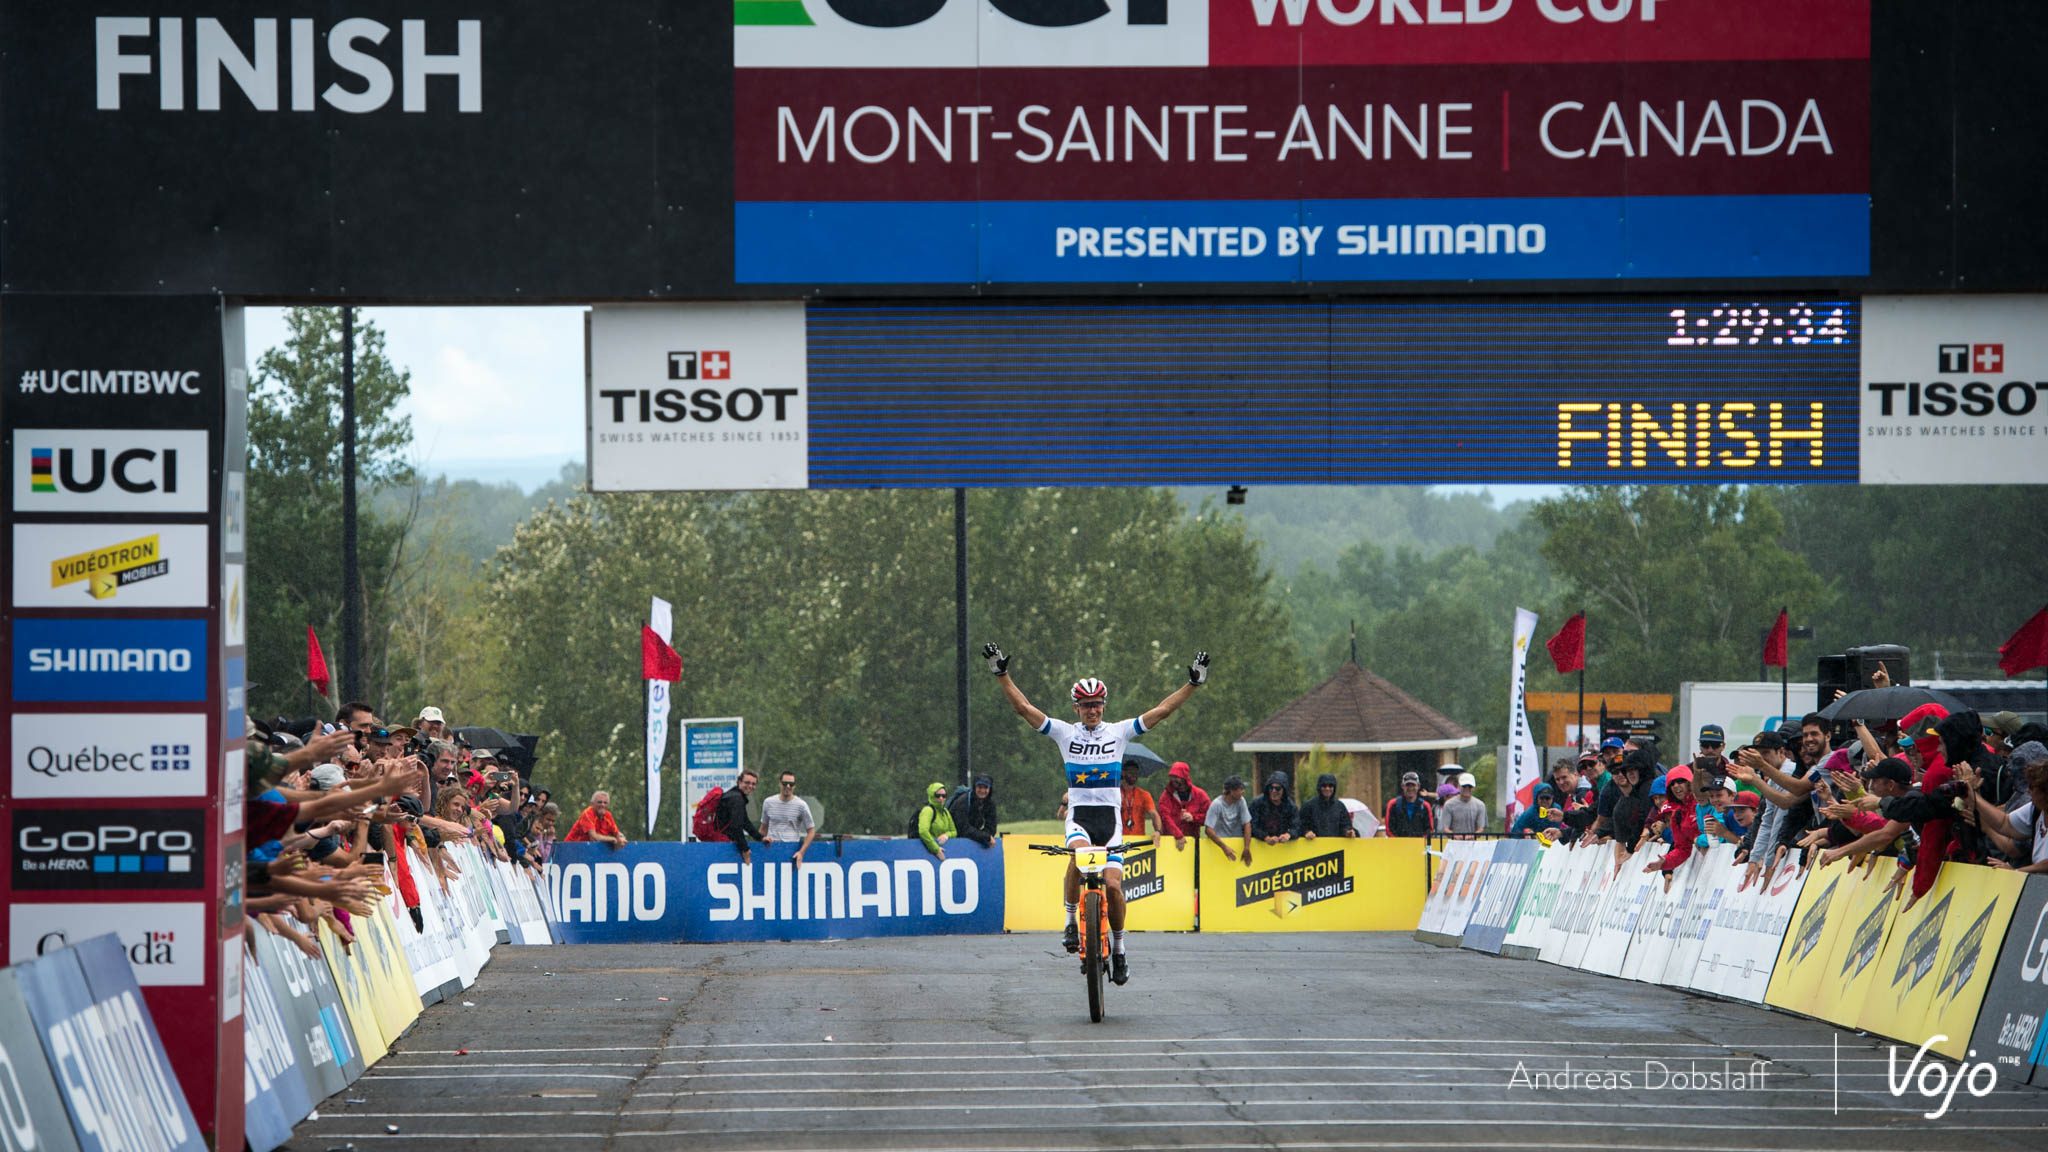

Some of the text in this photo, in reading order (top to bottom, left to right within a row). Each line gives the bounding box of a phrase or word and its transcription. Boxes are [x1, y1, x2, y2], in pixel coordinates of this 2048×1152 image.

[96, 17, 482, 113] FINISH
[777, 99, 1834, 163] MONT-SAINTE-ANNE CANADA
[1056, 223, 1547, 257] PRESENTED BY SHIMANO
[1667, 302, 1847, 346] 1:29:34
[20, 370, 201, 394] #UCIMTBWC
[600, 387, 798, 423] TISSOT
[600, 431, 800, 443] SWISS WATCHES SINCE 1853
[1558, 402, 1824, 466] FINISH
[1868, 426, 1913, 436] SWISS
[1920, 426, 1986, 436] WATCHES
[1993, 425, 2036, 436] SINCE
[59, 448, 177, 493] UCI
[58, 541, 154, 580] VIDÉOTRON
[122, 559, 168, 583] MOBILE
[29, 648, 191, 672] SHIMANO
[27, 746, 145, 777] Québec
[1069, 741, 1116, 755] BMC
[20, 826, 193, 852] GoPro
[1089, 853, 1096, 865] 2
[1122, 857, 1152, 881] RON
[707, 856, 979, 922] SHIMANO
[1125, 879, 1162, 900] MOBILE
[1242, 857, 1339, 898] VIDÉOTRON
[1307, 880, 1352, 902] MOBILE
